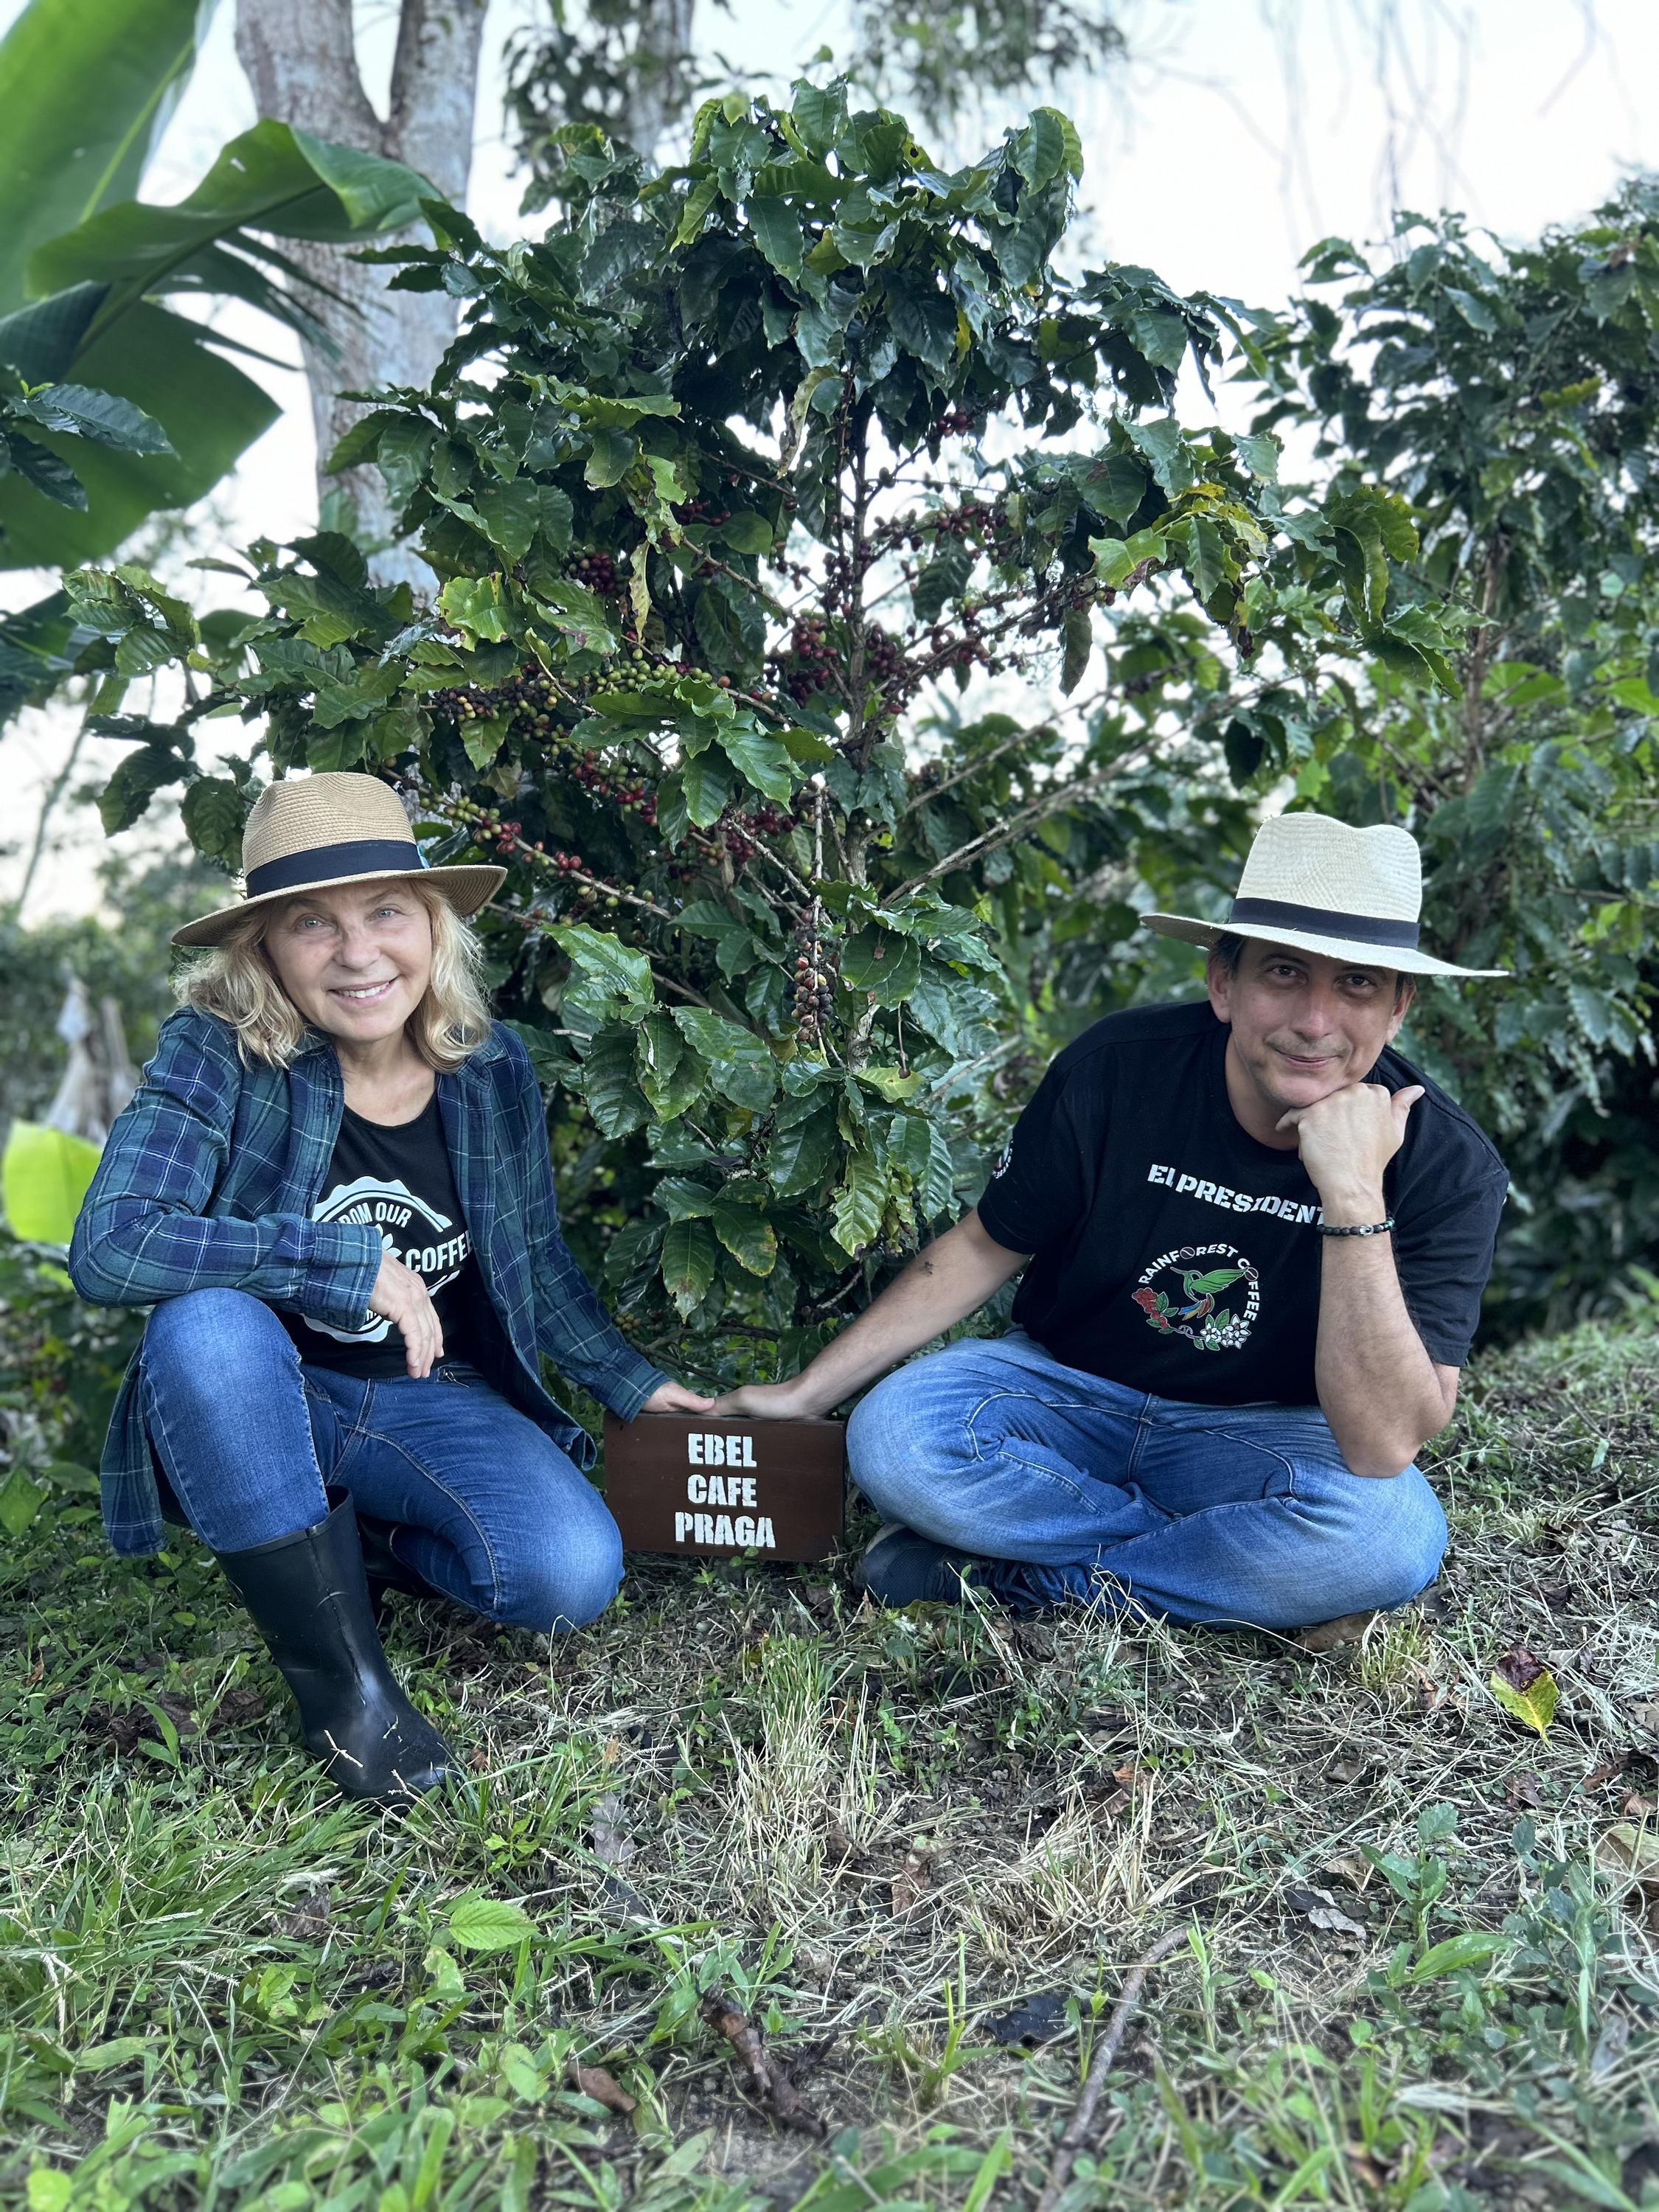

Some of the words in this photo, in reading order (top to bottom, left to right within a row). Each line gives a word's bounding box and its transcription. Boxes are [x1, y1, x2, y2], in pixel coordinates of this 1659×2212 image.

[375, 1201, 413, 1228] OUR
[1138, 1243, 1239, 1284] RAINFOREST
[687, 1433, 757, 1467] EBEL
[687, 1474, 758, 1507] CAFE
[675, 1512, 776, 1548] PRAGA
